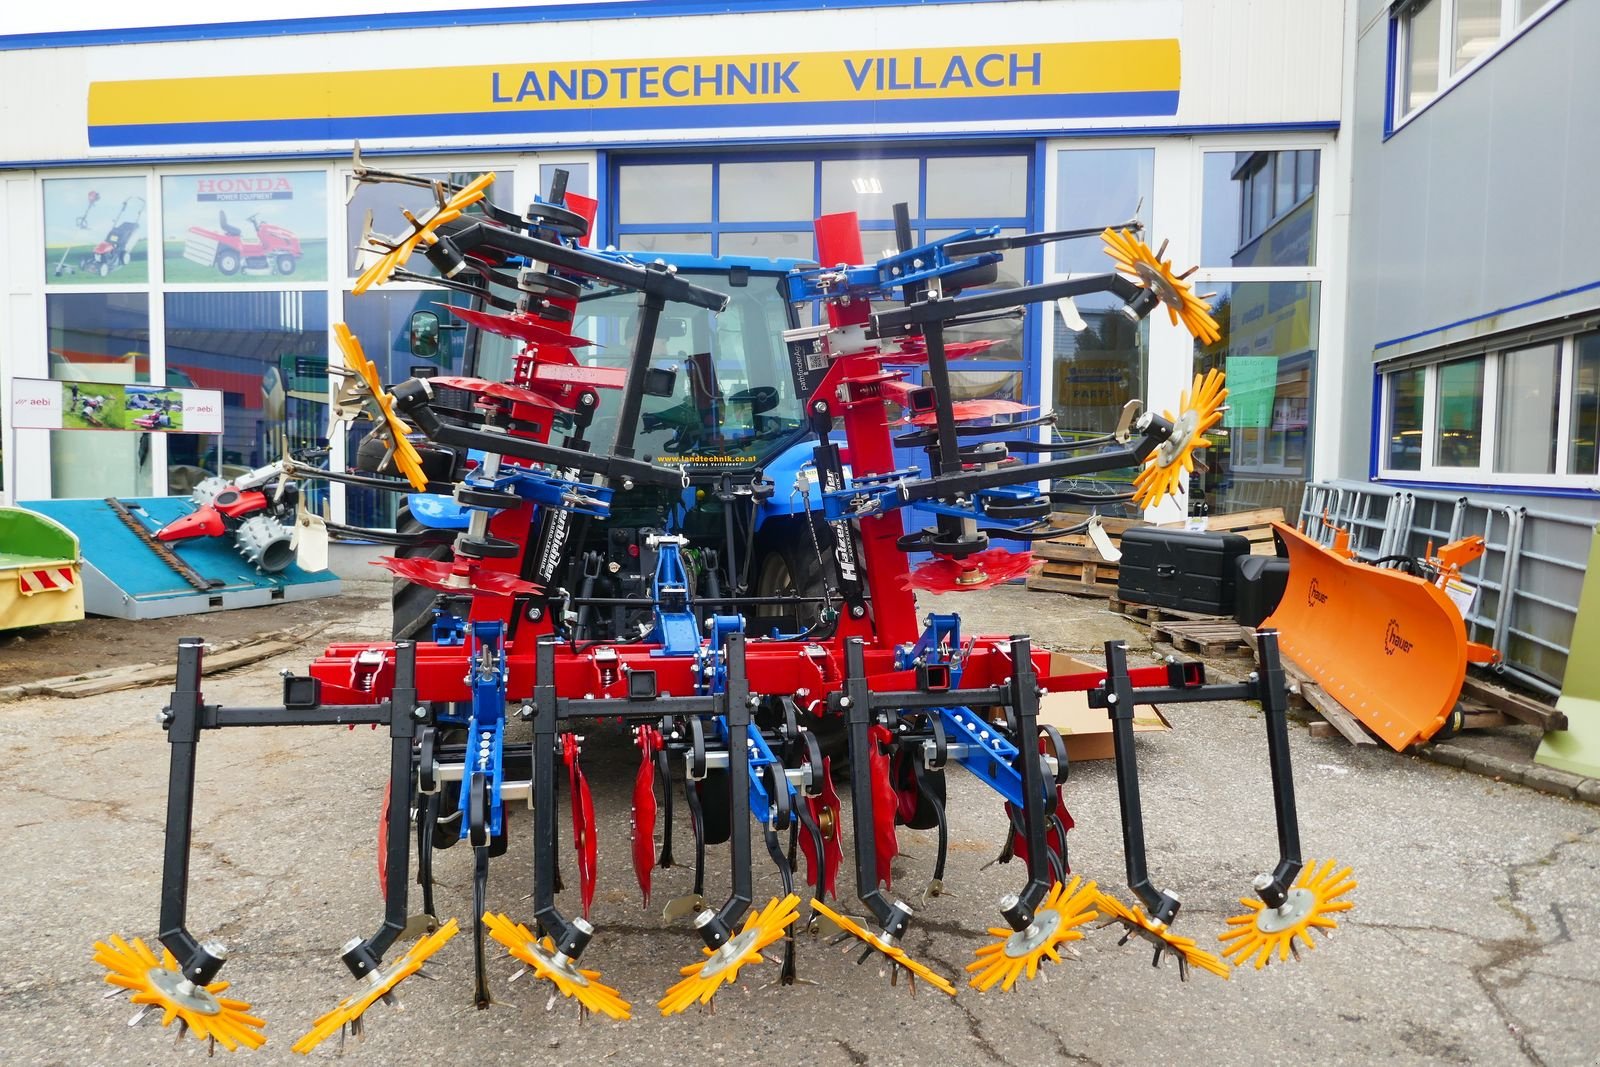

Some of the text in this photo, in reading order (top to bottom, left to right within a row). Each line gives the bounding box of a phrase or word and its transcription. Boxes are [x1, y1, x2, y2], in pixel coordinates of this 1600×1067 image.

[493, 52, 1041, 103] LANDTECHNIK VILLACH
[197, 176, 293, 193] HONDA
[216, 192, 273, 201] POWER EQUIPMENT
[30, 398, 50, 406] aebi
[196, 405, 213, 413] aebi
[657, 455, 757, 463] www.landtechnik.co.at
[543, 466, 580, 582] Henbichler
[1311, 584, 1328, 604] hauer
[1389, 627, 1414, 654] hauer
